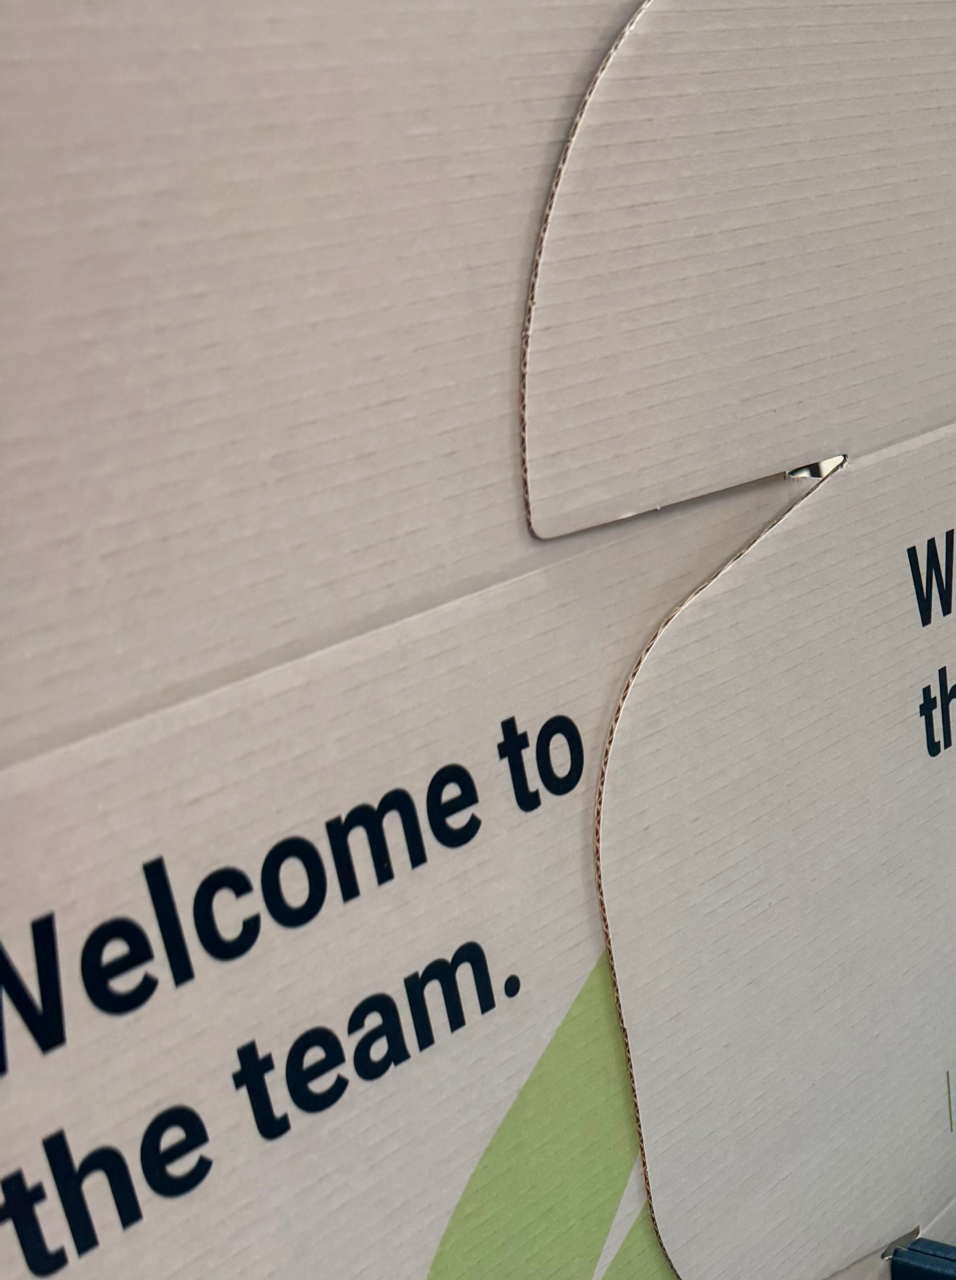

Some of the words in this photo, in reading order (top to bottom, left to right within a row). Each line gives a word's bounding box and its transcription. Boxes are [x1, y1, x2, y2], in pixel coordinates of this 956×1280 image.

[498, 714, 585, 813] to
[0, 1105, 213, 1278] the
[232, 941, 521, 1141] team.
